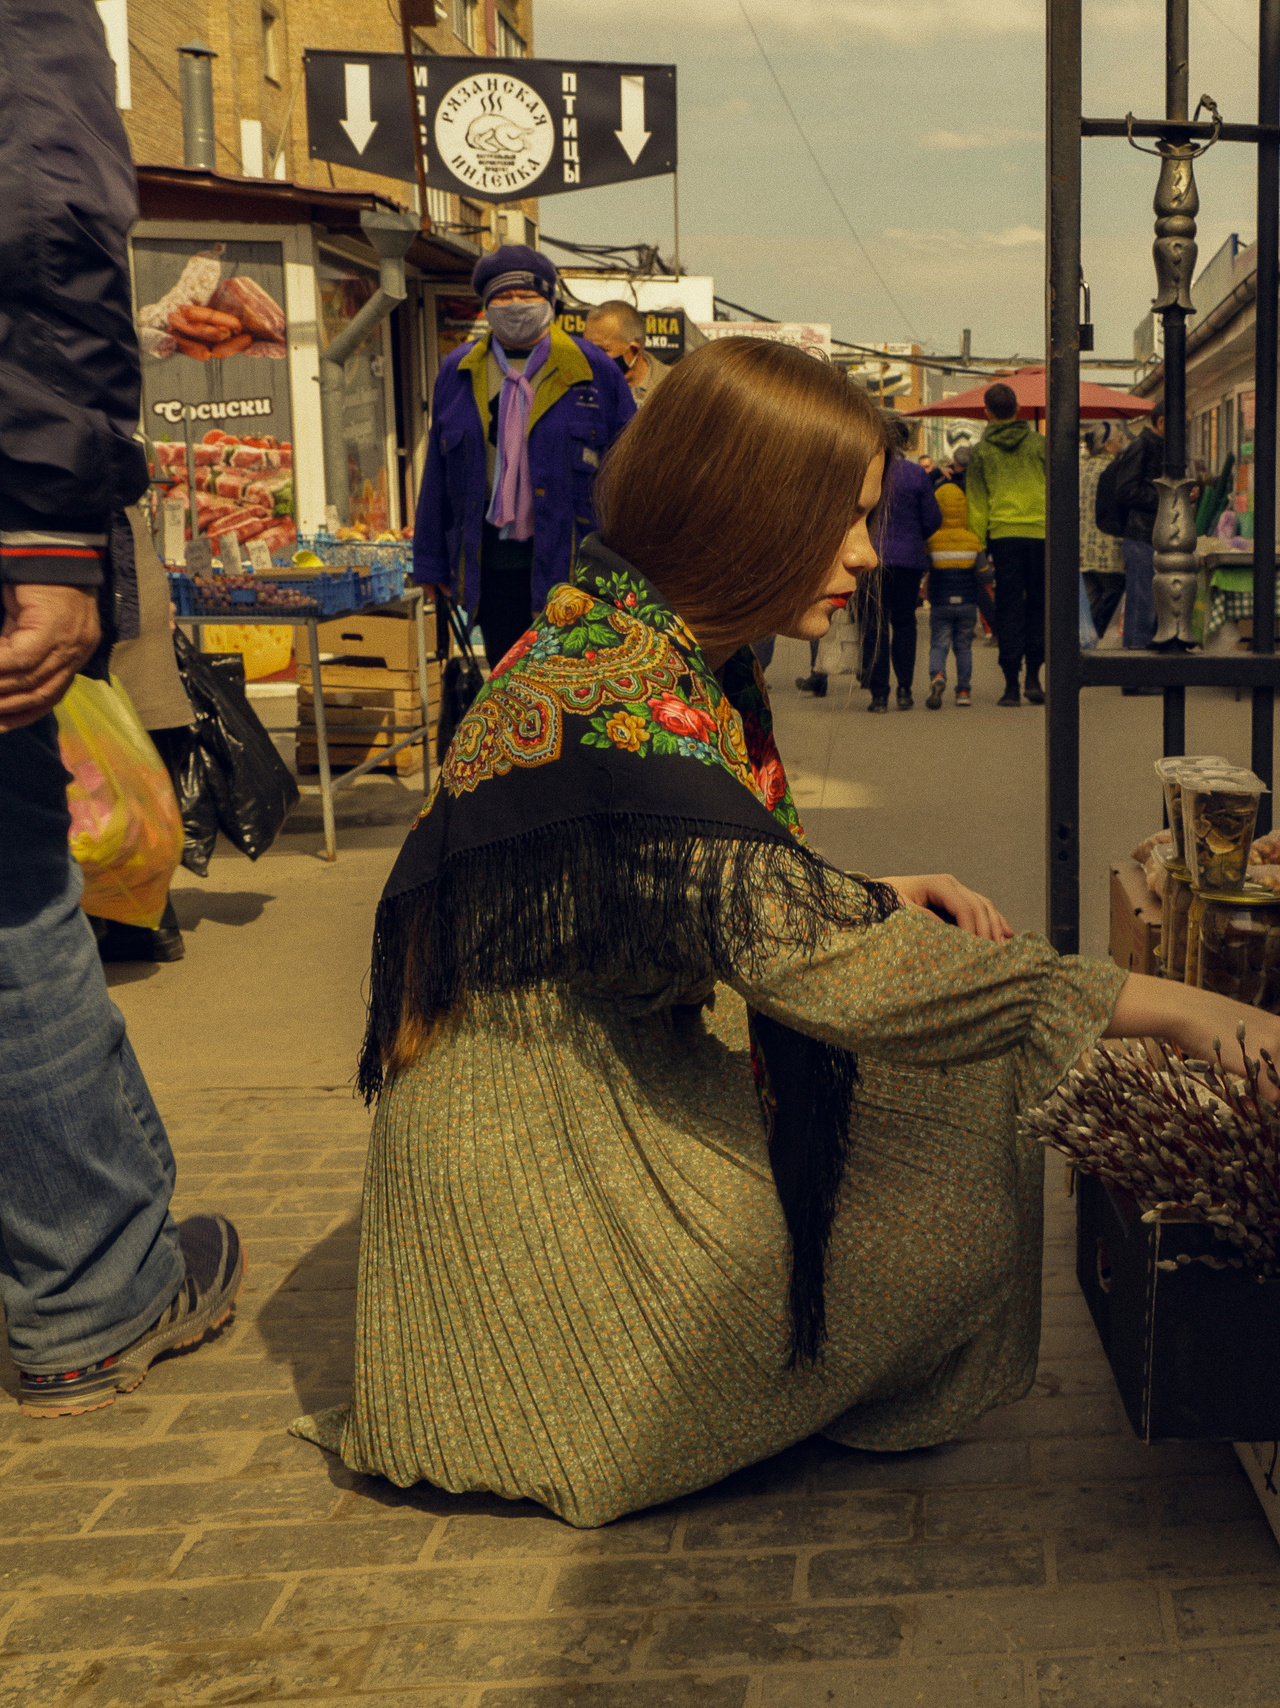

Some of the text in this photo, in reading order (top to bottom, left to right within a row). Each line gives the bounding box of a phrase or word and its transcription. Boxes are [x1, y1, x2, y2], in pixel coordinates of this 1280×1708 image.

[442, 78, 548, 126] РЯЗАНСКАЯ
[561, 72, 580, 183] ПТИЦЫ
[556, 313, 586, 333] УСЬ
[645, 314, 680, 335] ЙКА
[645, 335, 679, 349] ЬКО...
[153, 397, 272, 423] Сосиски
